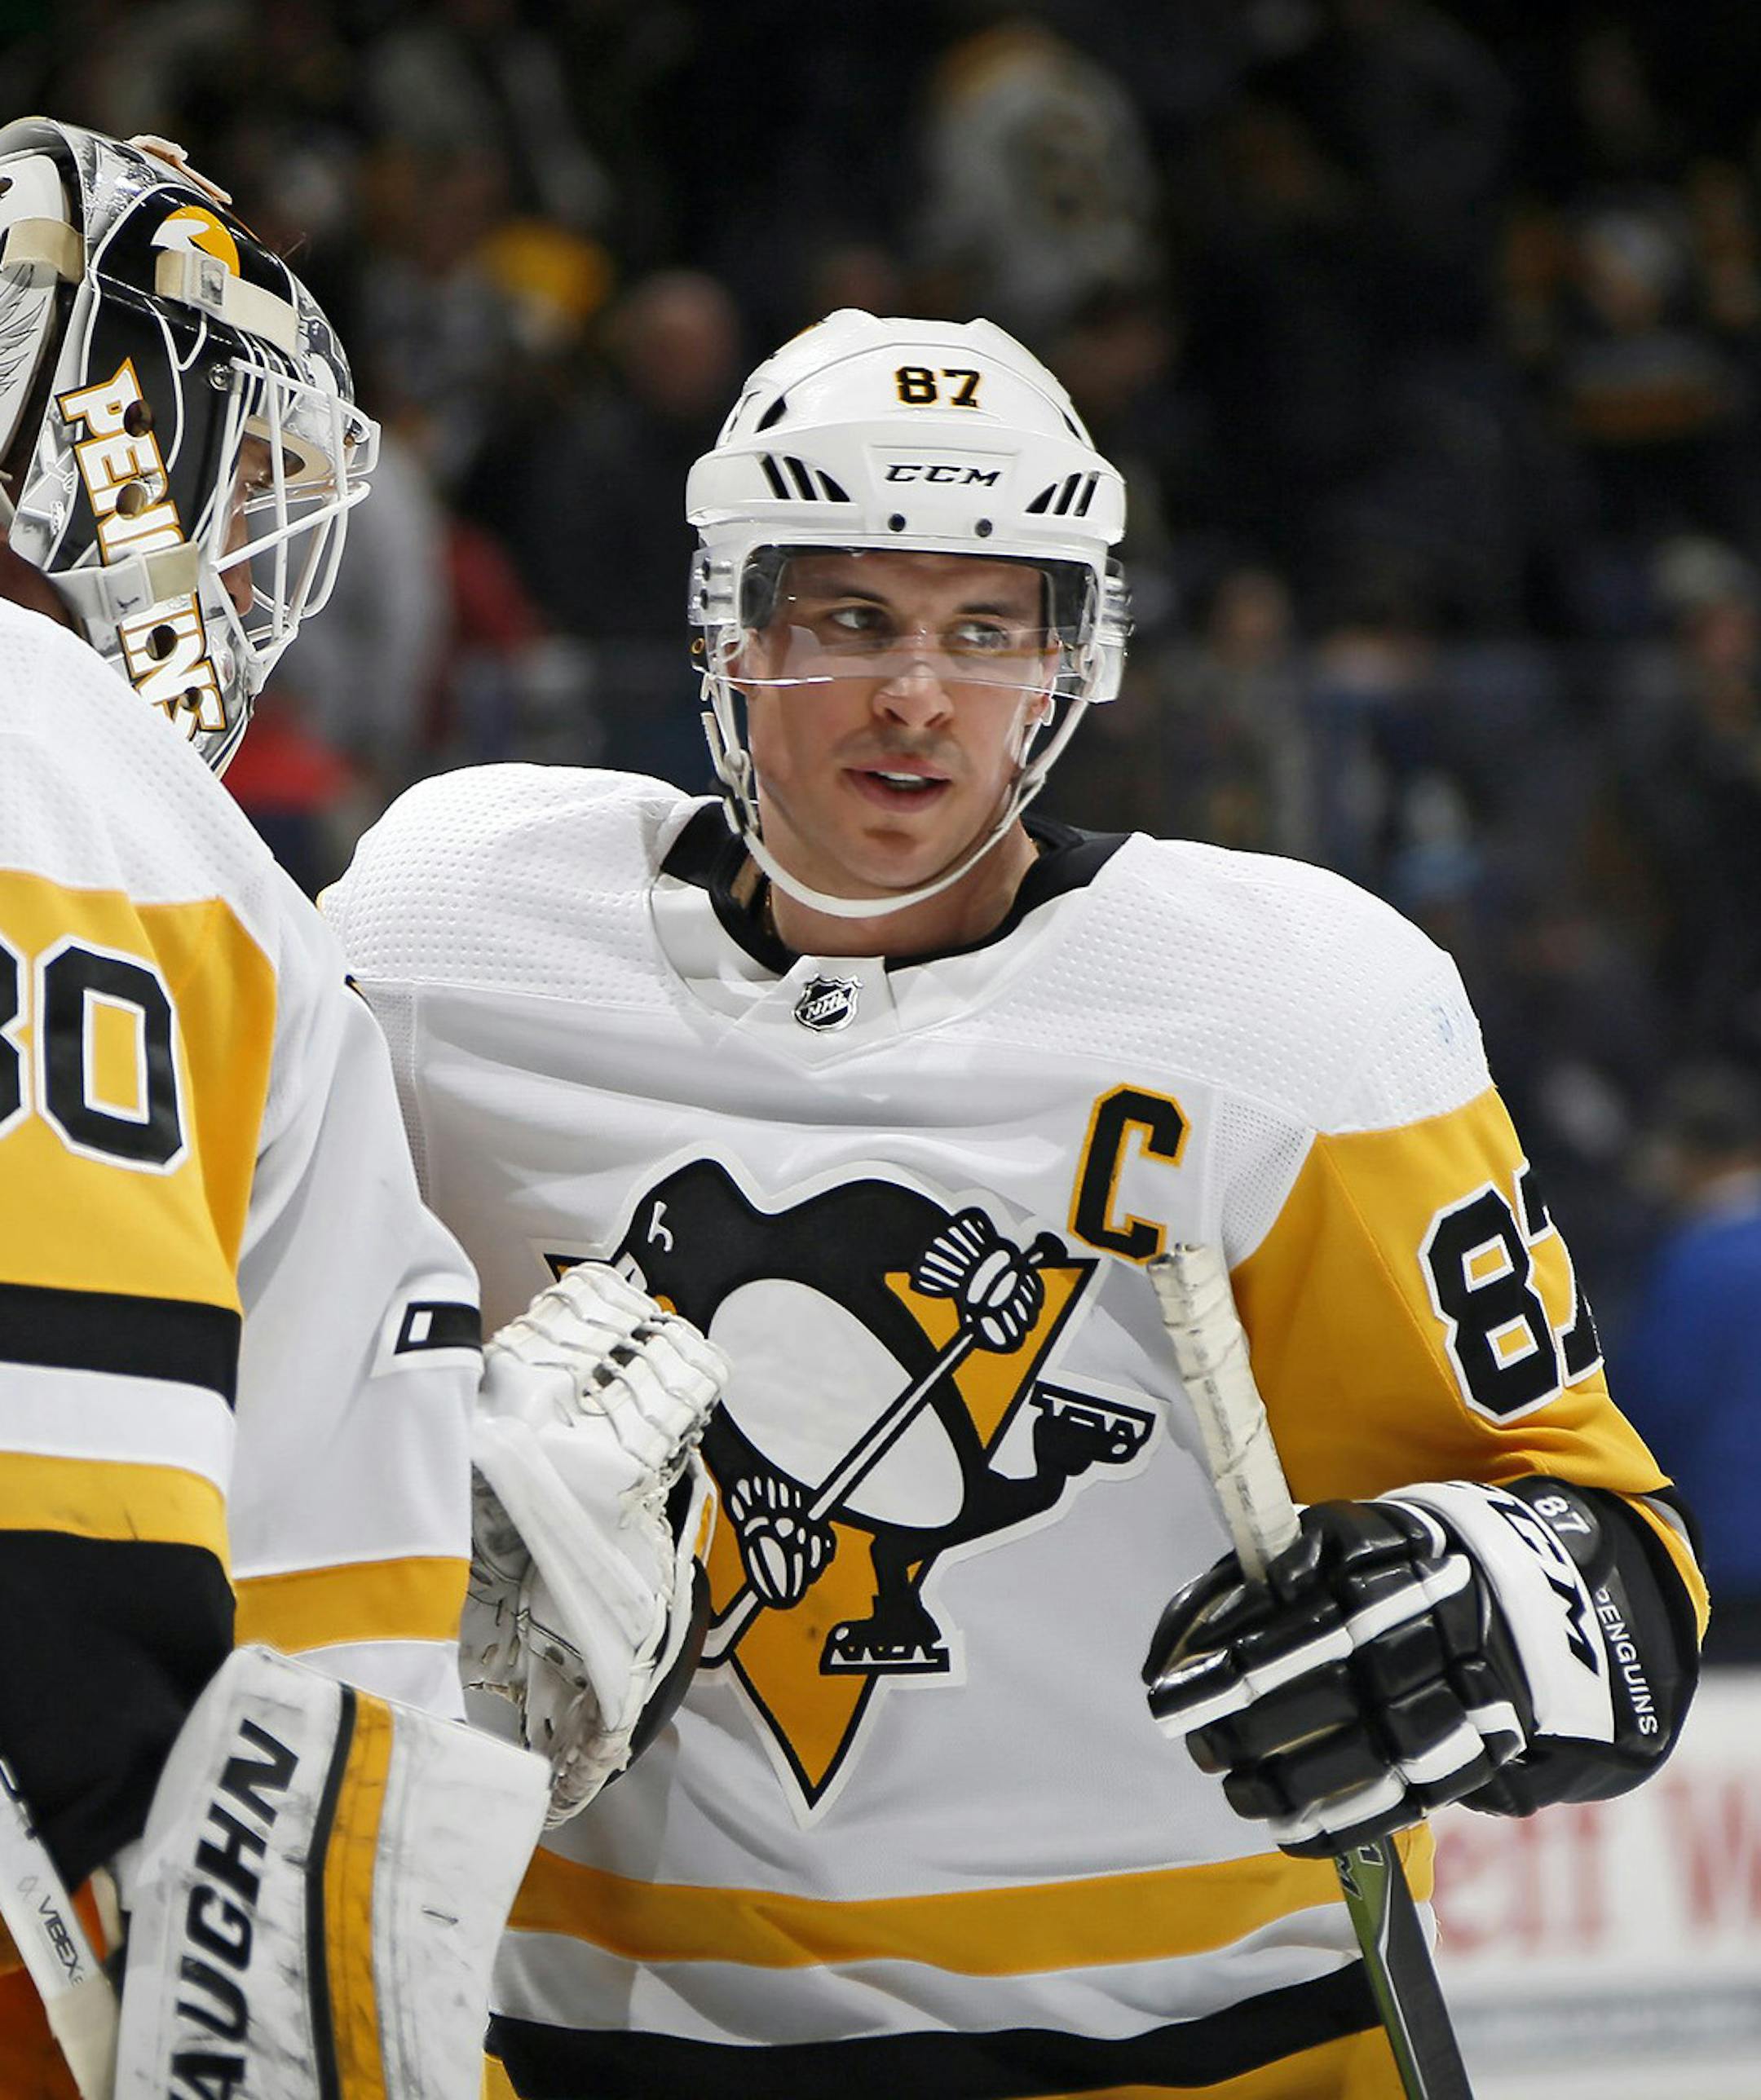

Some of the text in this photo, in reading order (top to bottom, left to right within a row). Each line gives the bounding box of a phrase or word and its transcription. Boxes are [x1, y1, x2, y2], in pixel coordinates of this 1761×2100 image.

[894, 366, 983, 408] 87
[885, 463, 1003, 487] CCM
[55, 356, 227, 742] PENINS
[0, 932, 192, 1176] 0
[804, 989, 849, 1021] NHL
[1067, 1082, 1192, 1266] C
[1534, 1494, 1592, 1536] 87
[166, 1718, 299, 2100] AUGHN
